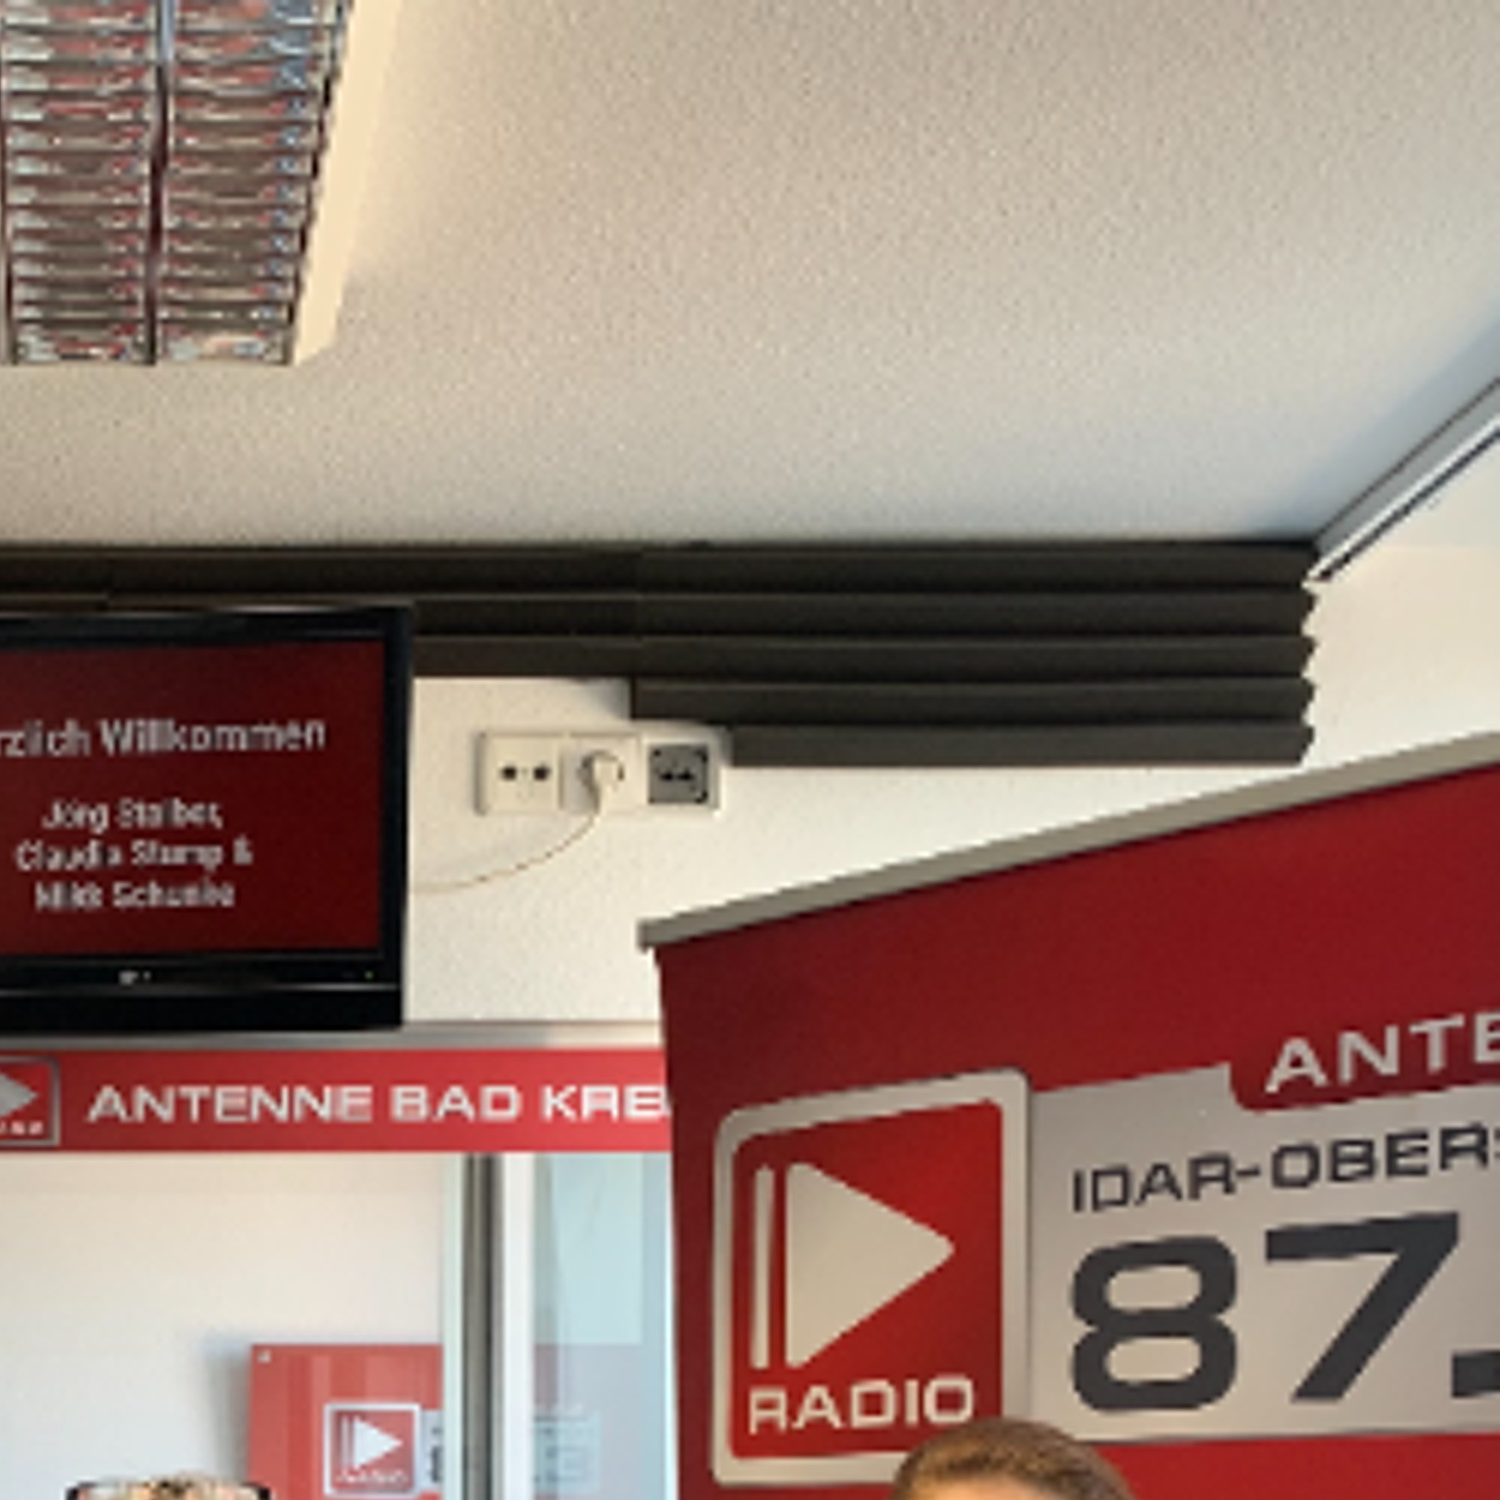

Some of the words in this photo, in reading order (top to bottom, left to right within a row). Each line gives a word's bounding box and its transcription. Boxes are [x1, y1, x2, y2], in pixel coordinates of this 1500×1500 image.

[100, 718, 327, 756] Willkommen
[15, 837, 122, 873] Claudia
[232, 832, 253, 866] &
[85, 1084, 374, 1124] ANTENNE
[389, 1084, 522, 1123] BAD
[747, 1374, 976, 1436] RADIO
